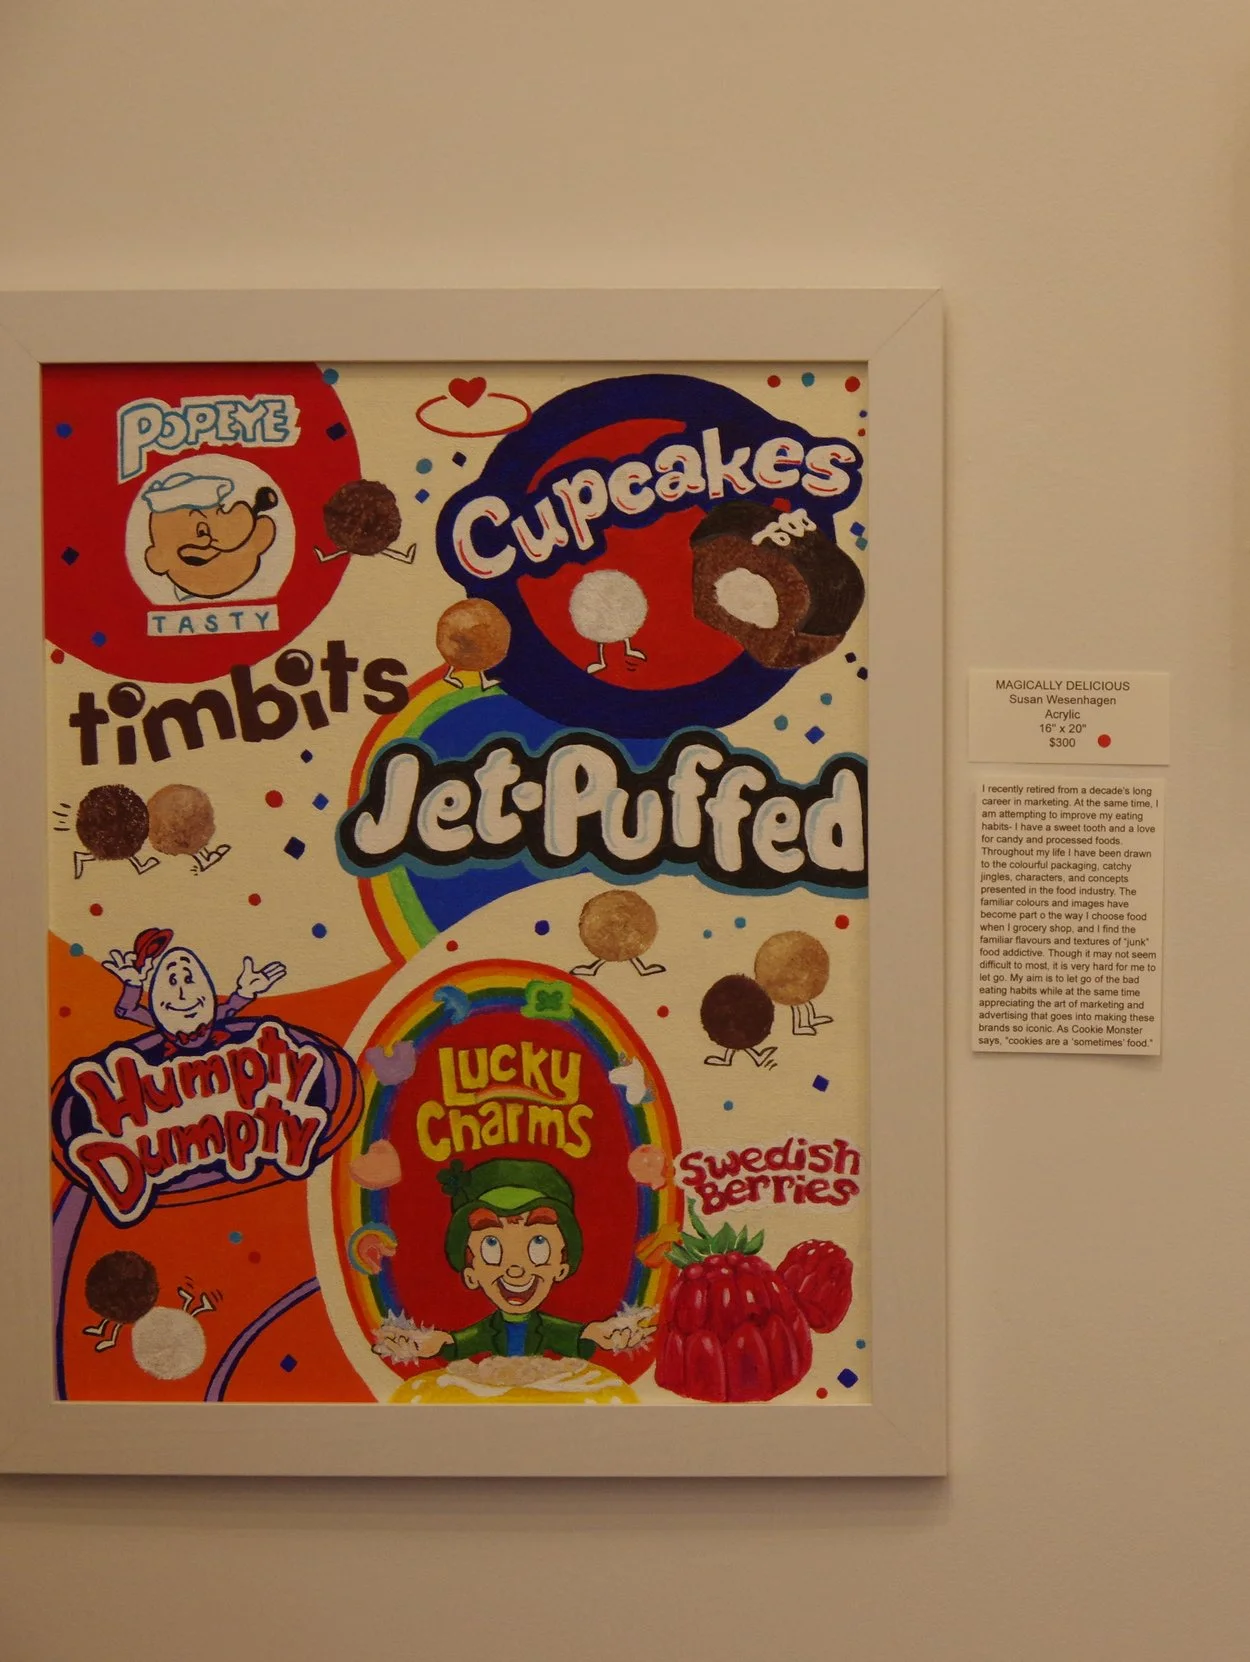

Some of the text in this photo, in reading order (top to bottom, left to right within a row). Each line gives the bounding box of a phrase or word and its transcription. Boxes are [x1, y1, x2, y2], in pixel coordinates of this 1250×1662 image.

[119, 398, 291, 481] POPEYE
[452, 427, 856, 579] Cupcakes
[152, 611, 270, 633] TASTY
[996, 680, 1130, 691] MAGICALLY DELICIOUS
[69, 640, 410, 766] timbits
[1010, 694, 1116, 707] Susan Wesenhagen
[1045, 709, 1080, 721] Acrylic
[1050, 737, 1075, 748] $300
[988, 785, 1023, 795] recently
[1026, 785, 1055, 794] retired
[1058, 785, 1078, 794] from
[1133, 787, 1152, 797] long
[355, 743, 865, 873] Jet-Puffed
[999, 810, 1046, 821] attempting
[1049, 811, 1058, 819] to
[1060, 810, 1096, 821] improve
[1100, 813, 1113, 822] my
[1116, 812, 1143, 822] eating
[982, 835, 994, 843] for
[996, 835, 1023, 845] candy
[1046, 836, 1092, 846] processed
[1095, 836, 1122, 845] foods.
[981, 860, 1132, 872] to the colourful packaging, catchy
[980, 872, 1128, 884] jingles, characters, and concepts
[981, 886, 1136, 897] presented in the food industry. The
[980, 897, 1129, 909] familiar colours and images have
[980, 935, 1013, 944] familiar
[1016, 936, 1051, 944] flavours
[1054, 937, 1071, 945] and
[1074, 937, 1110, 946] textures
[1112, 938, 1121, 946] of
[979, 986, 1007, 996] eating
[1010, 986, 1037, 995] habits
[1040, 987, 1062, 995] while
[1065, 987, 1074, 995] at
[1077, 987, 1091, 996] the
[1121, 988, 1140, 996] time
[979, 999, 1034, 1009] appreciating
[1037, 999, 1052, 1008] the
[1054, 1000, 1066, 1008] art
[1068, 1000, 1078, 1008] of
[1080, 1001, 1124, 1010] marketing
[979, 1011, 1154, 1023] advertising that goes into making these
[978, 1038, 1002, 1046] says,
[438, 1041, 581, 1106] Lucky
[75, 1026, 318, 1138] Humpty
[416, 1100, 594, 1162] Charms
[76, 1095, 319, 1213] Dumpty
[680, 1137, 860, 1186] Swedish
[694, 1174, 860, 1215] Berries
